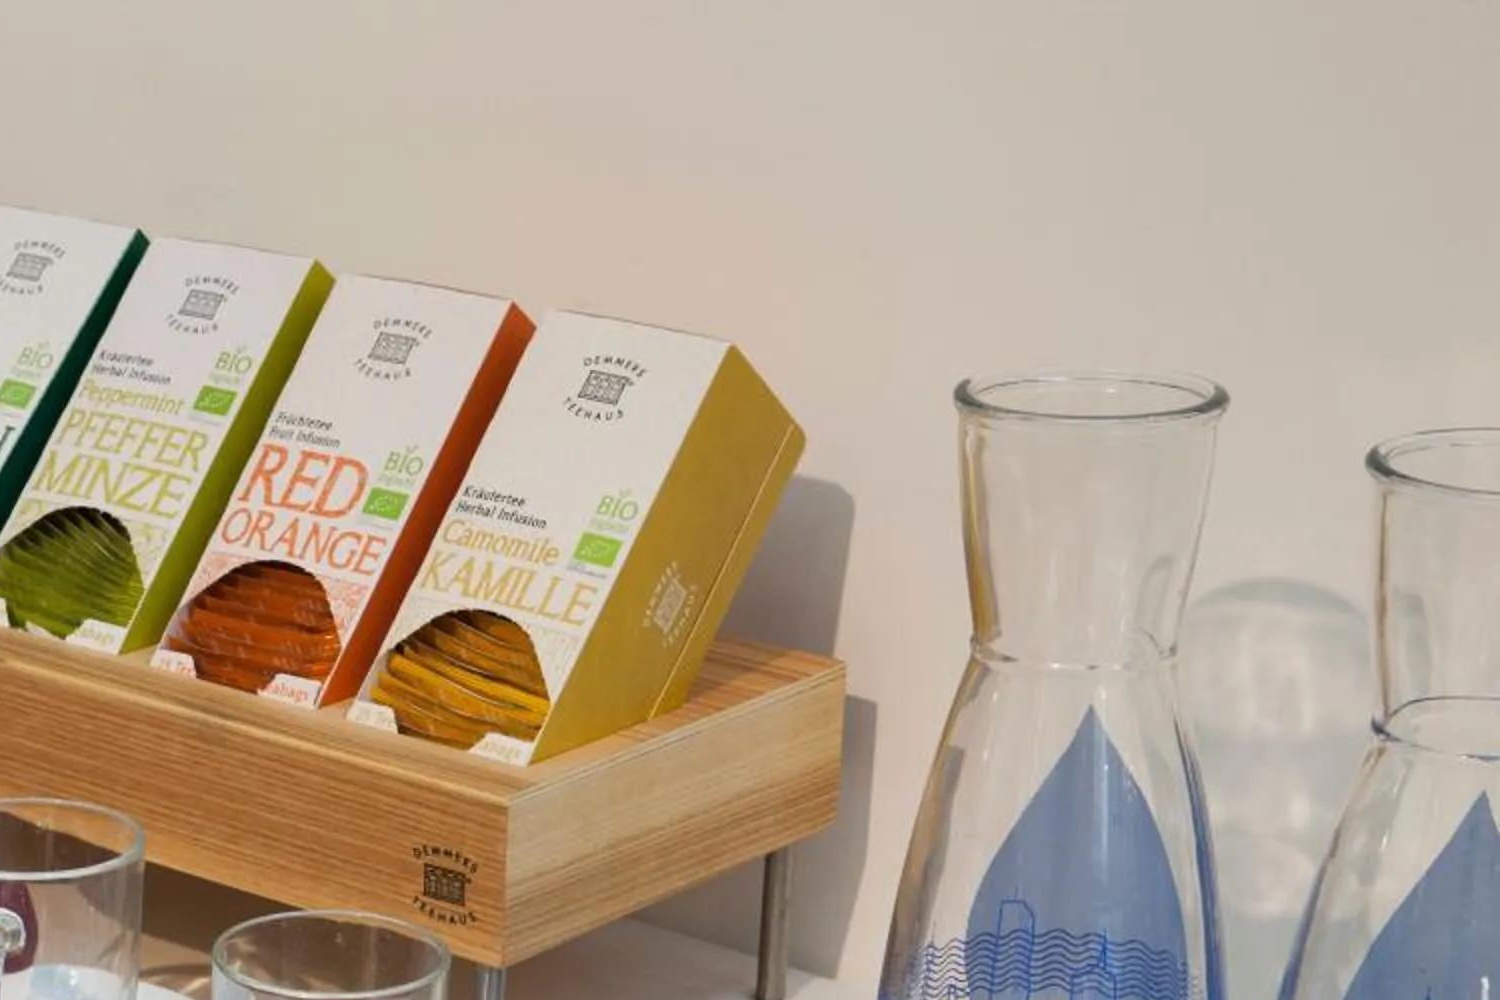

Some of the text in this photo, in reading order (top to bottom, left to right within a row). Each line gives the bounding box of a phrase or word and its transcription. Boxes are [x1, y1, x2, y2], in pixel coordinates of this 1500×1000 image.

[16, 345, 54, 370] BIO
[214, 350, 253, 375] BIO
[583, 354, 649, 379] DEMMERS
[77, 379, 185, 417] Peppermint
[51, 410, 209, 473] PFEFFER
[236, 443, 370, 519] RED
[384, 450, 424, 477] BIO
[30, 451, 192, 520] MINZE
[454, 499, 549, 530] Herbal Infusion
[595, 494, 639, 522] BIO
[220, 507, 388, 577] ORANGE
[441, 517, 562, 567] Camomile
[418, 551, 599, 628] KAMILLE
